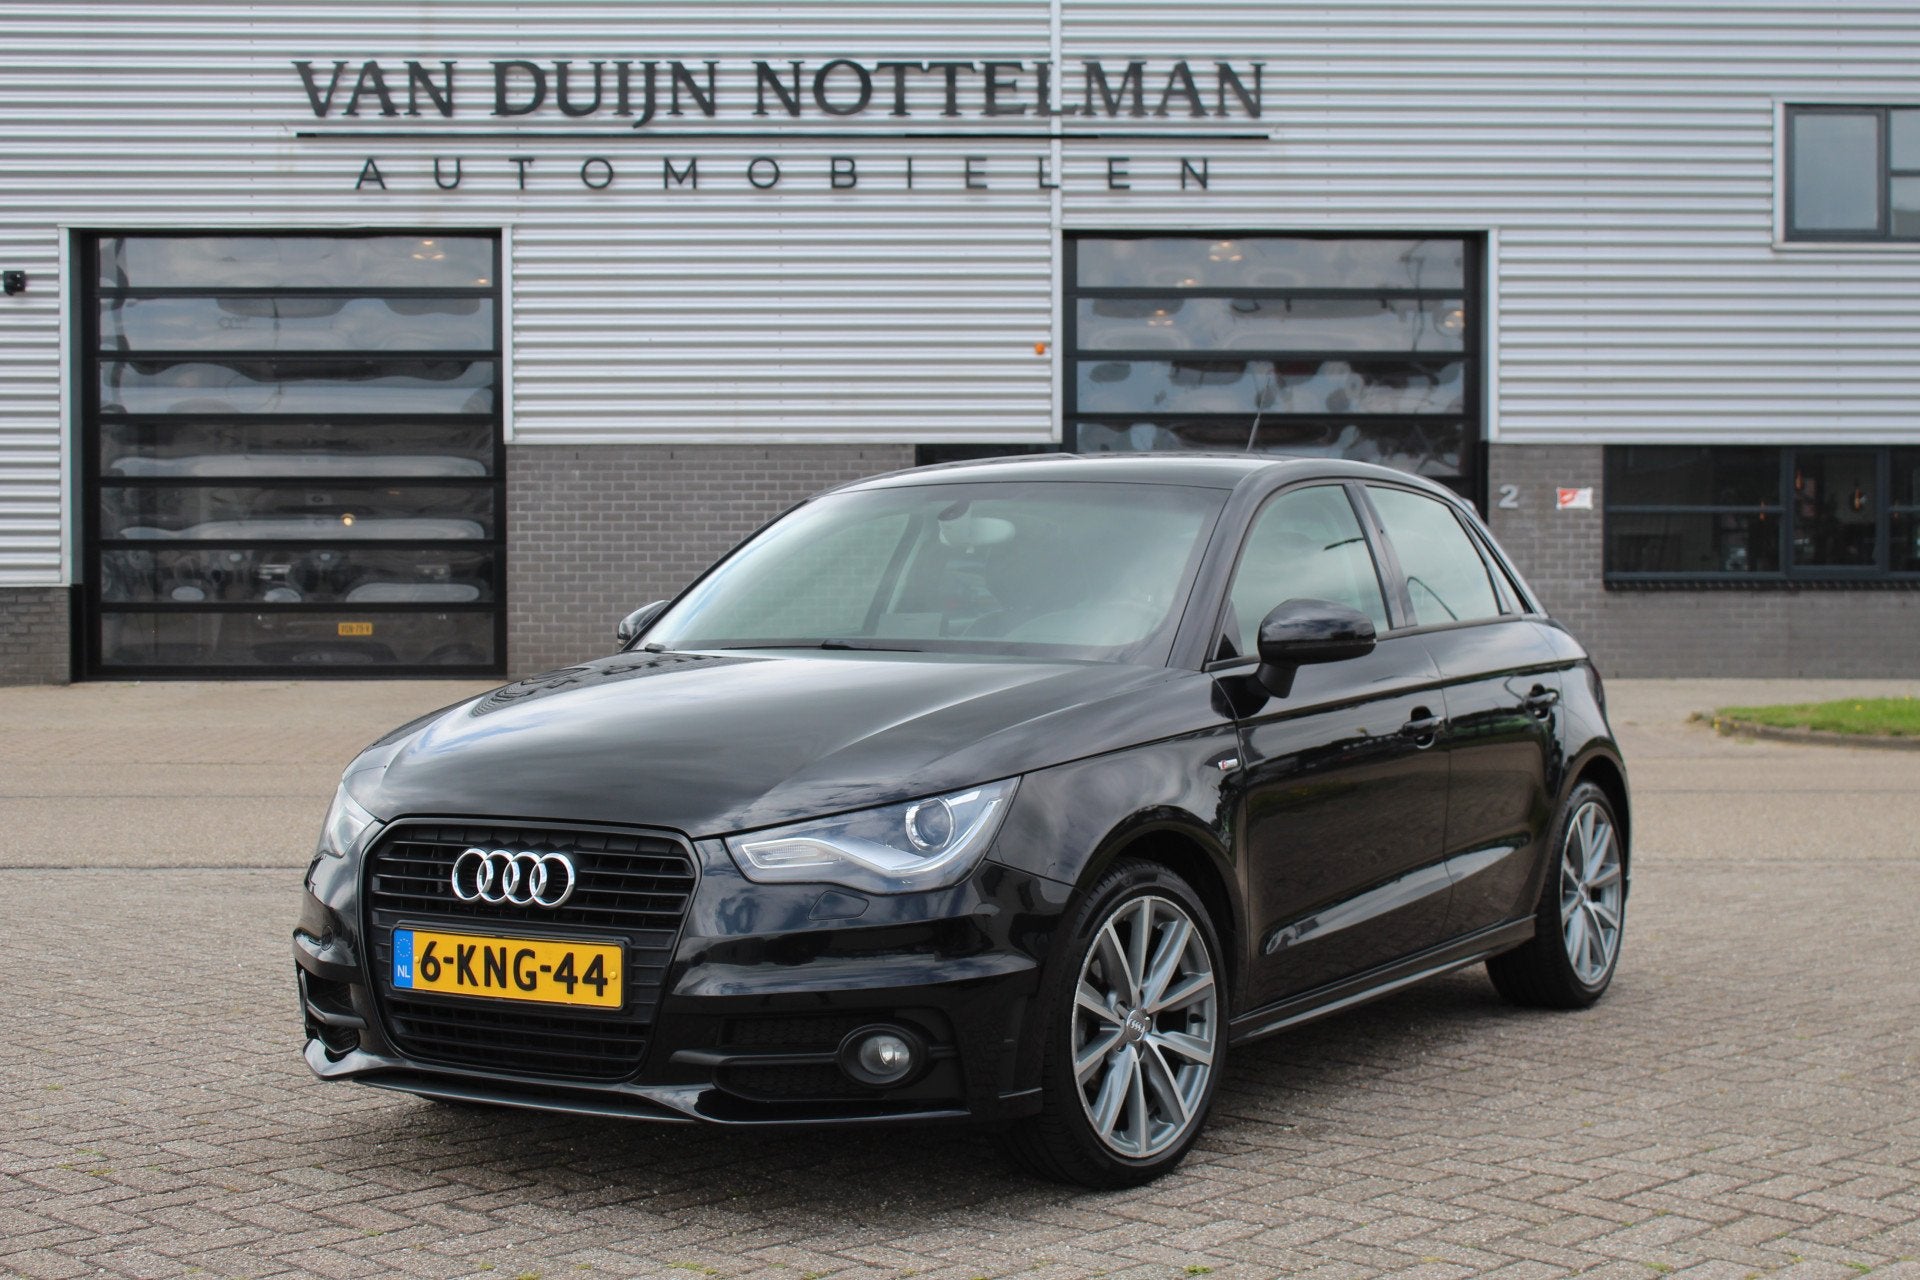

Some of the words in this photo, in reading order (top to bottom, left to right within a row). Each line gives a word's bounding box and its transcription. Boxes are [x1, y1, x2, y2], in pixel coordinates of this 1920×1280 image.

[292, 60, 457, 117] VAN
[490, 60, 719, 128] DUIJN
[753, 59, 1266, 117] NOTTELMAN
[355, 157, 1209, 190] AUTOMOBIELEN
[1499, 484, 1518, 508] 2
[397, 965, 410, 978] NL
[420, 941, 608, 997] 6-KNG-44
